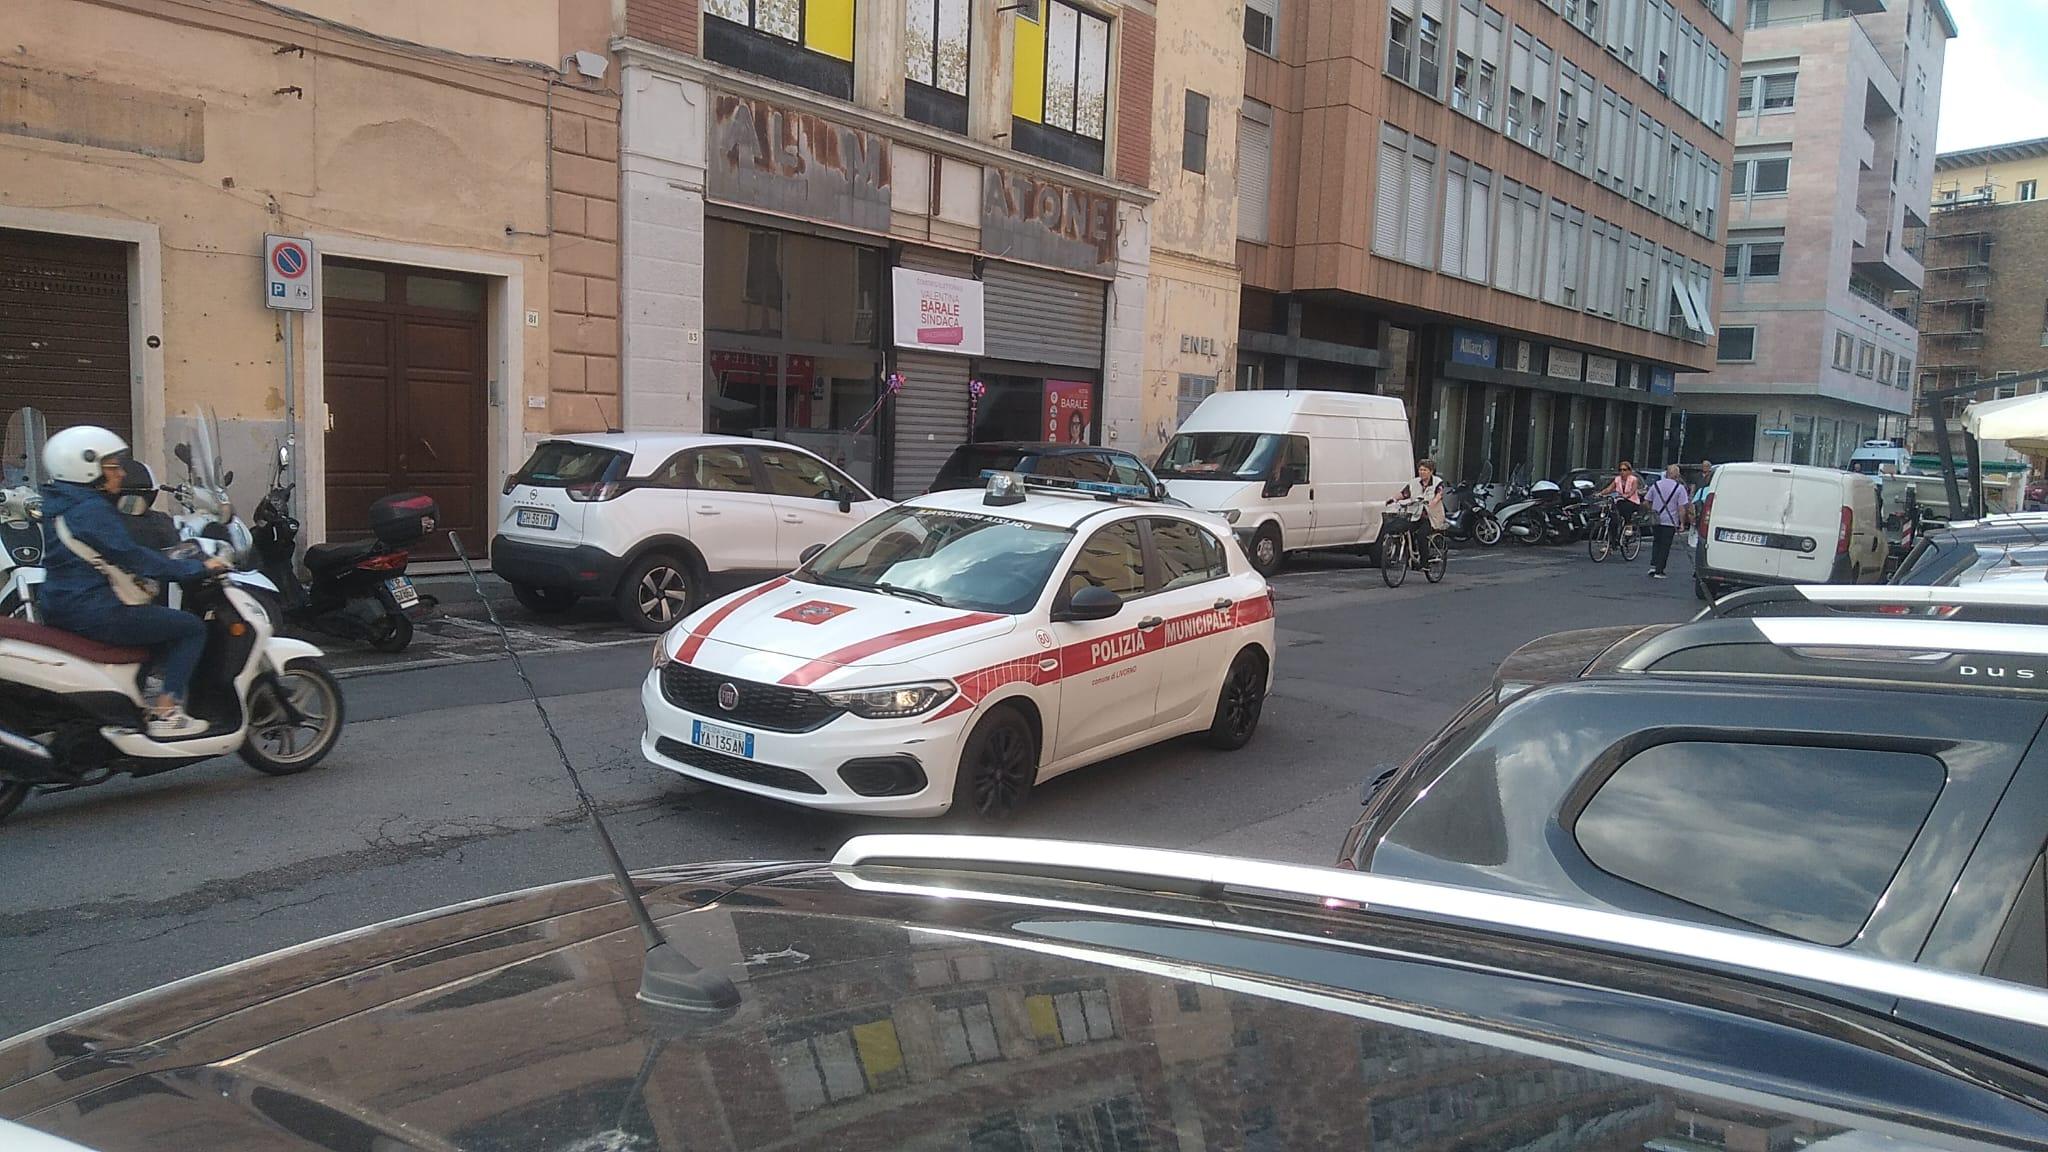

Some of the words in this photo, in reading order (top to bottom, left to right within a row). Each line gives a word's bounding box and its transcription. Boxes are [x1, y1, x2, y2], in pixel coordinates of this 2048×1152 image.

[920, 299, 960, 317] BARALE
[921, 313, 960, 328] SINDACA
[1180, 334, 1218, 357] ENEL
[1060, 398, 1088, 409] BARALE
[1038, 632, 1049, 644] 80
[1091, 631, 1146, 664] POLIZIA
[1165, 611, 1232, 643] MUNICIPALE
[1092, 674, 1111, 686] comune
[1115, 665, 1138, 680] LIVORNO
[1960, 665, 2048, 679] DUS
[715, 735, 745, 755] 135AN
